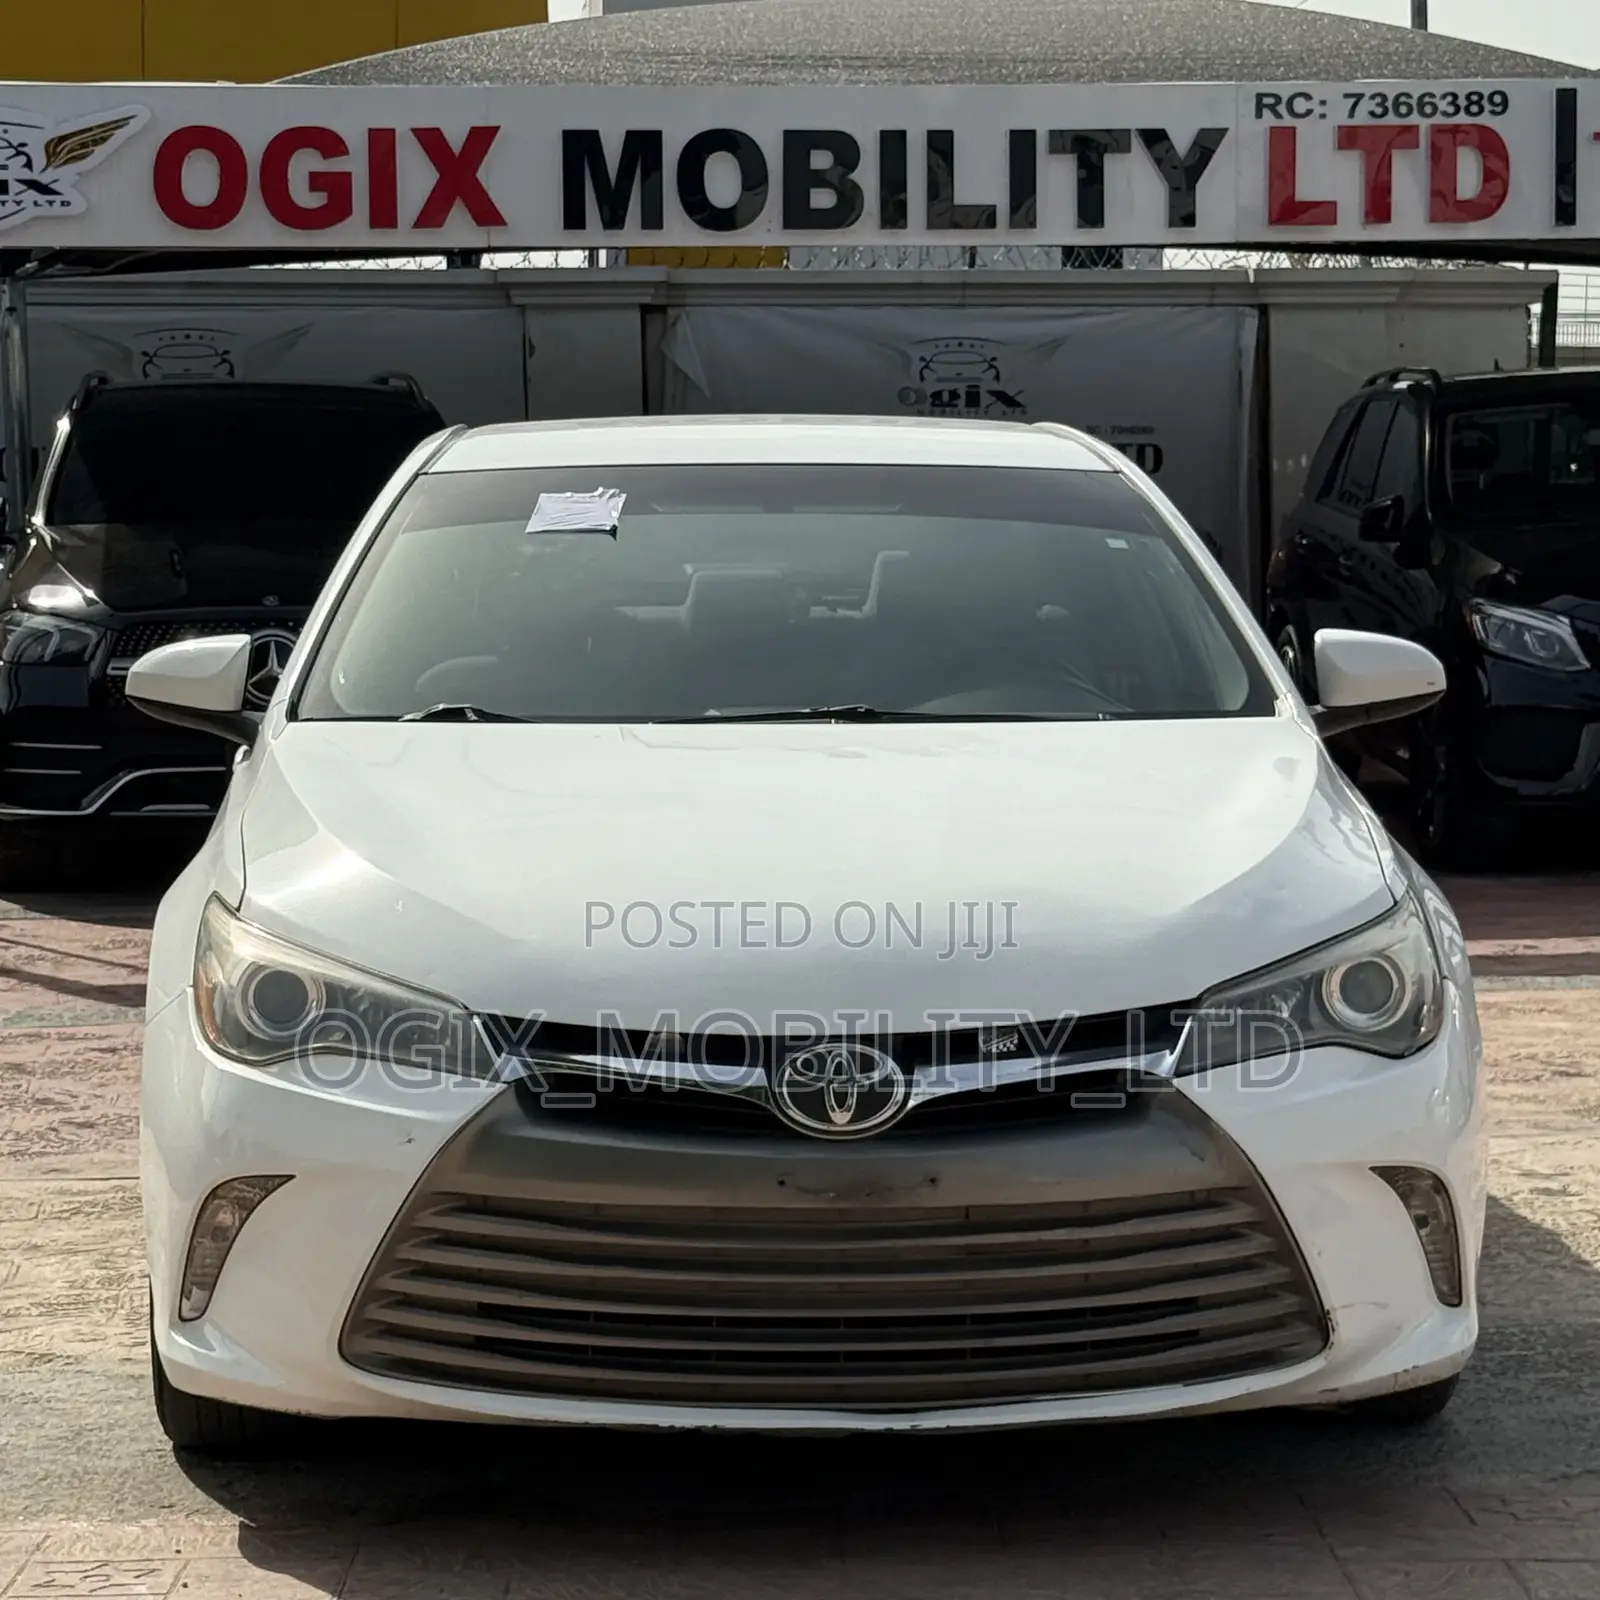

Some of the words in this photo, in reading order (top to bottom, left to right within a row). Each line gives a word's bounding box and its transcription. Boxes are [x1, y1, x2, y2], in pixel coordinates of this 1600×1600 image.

[1254, 92, 1327, 120] RC:
[1342, 90, 1510, 119] 7366389
[153, 125, 508, 230] OGIX
[561, 128, 1230, 231] MOBILITY
[1268, 124, 1511, 226] LTD
